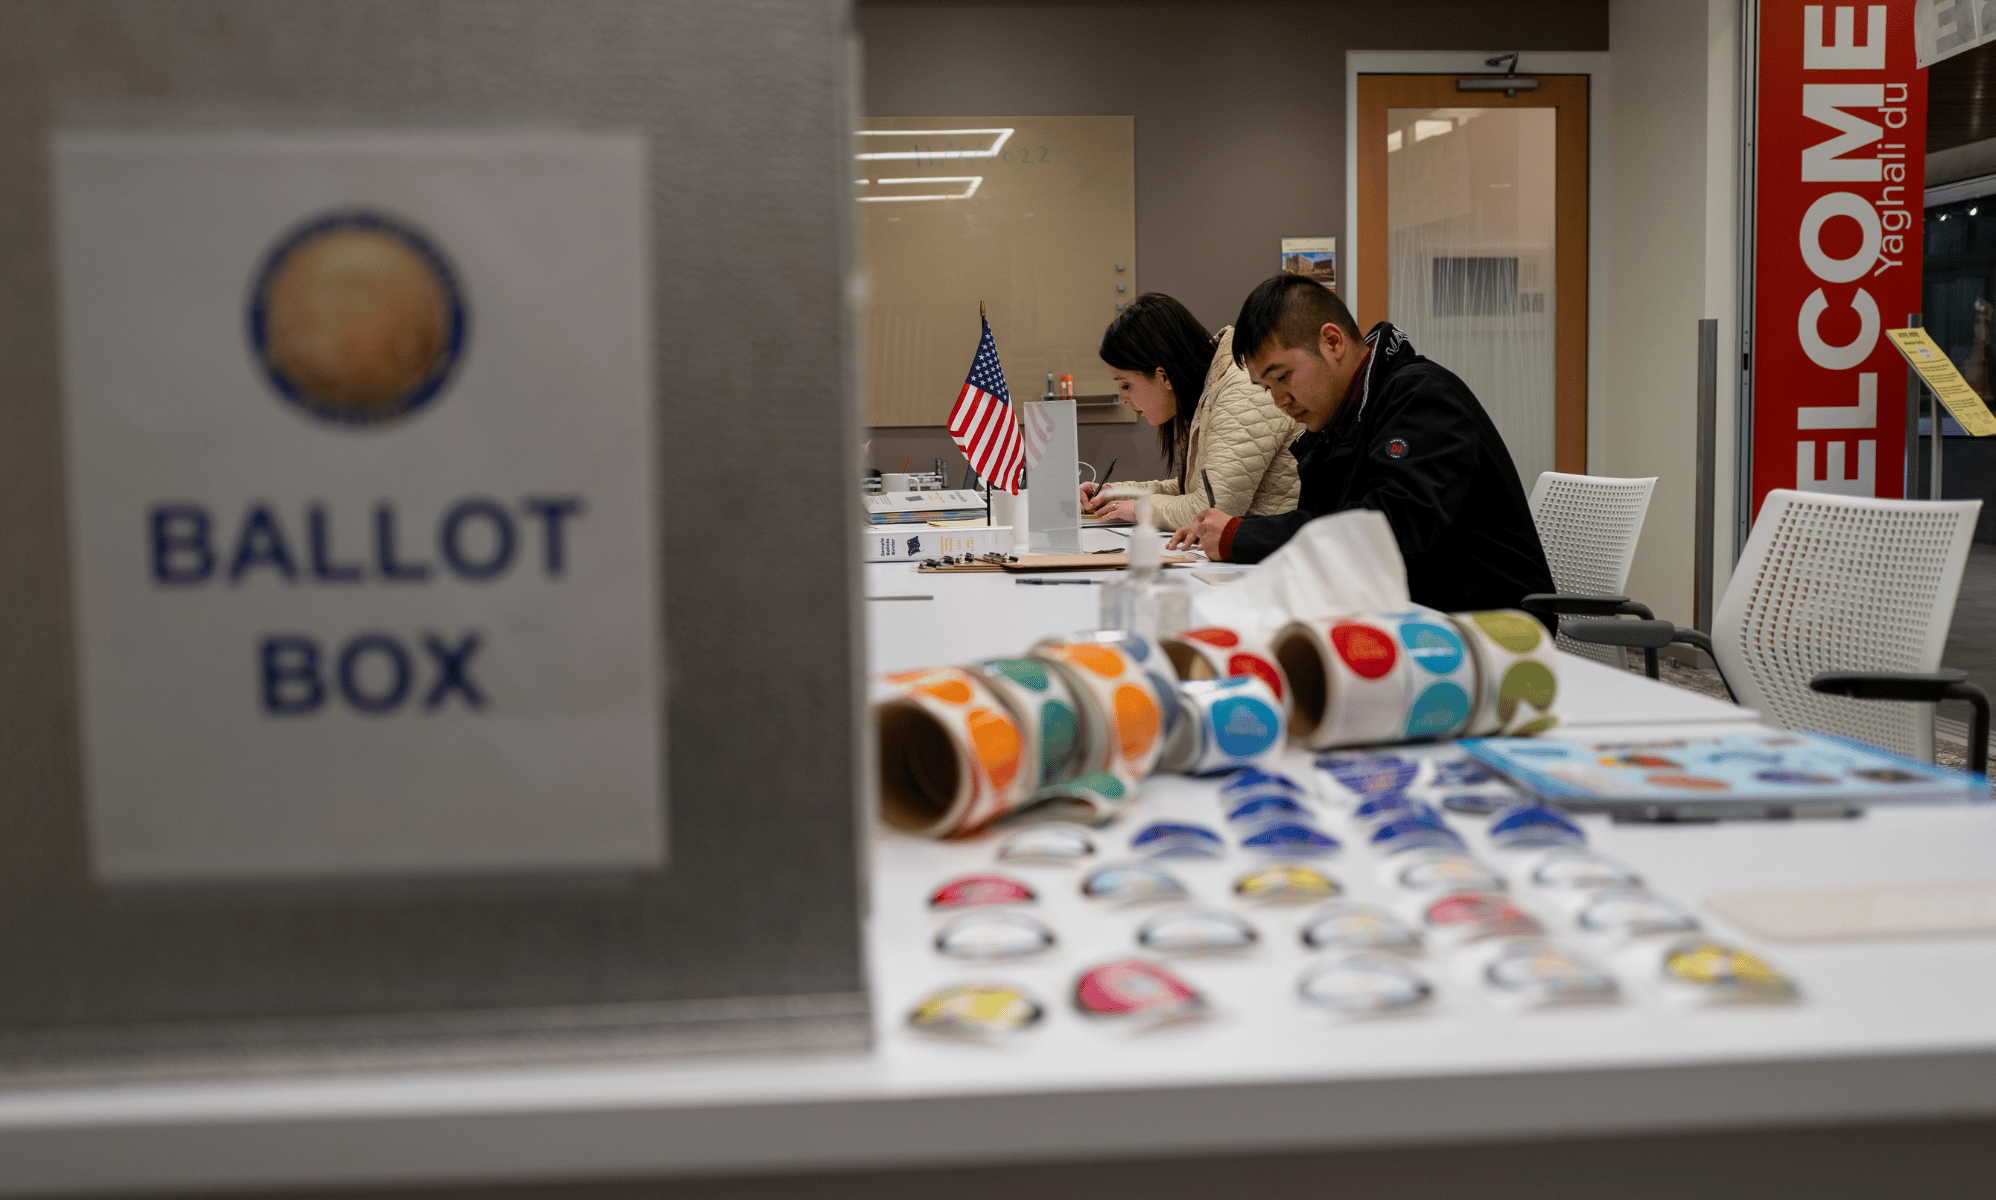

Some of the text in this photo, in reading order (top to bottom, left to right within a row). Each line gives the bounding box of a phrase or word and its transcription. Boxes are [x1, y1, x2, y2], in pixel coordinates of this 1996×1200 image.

[1796, 4, 1887, 497] ELCOME
[1873, 82, 1912, 277] Yaghali du
[147, 494, 586, 588] BALLOT
[258, 626, 489, 717] BOX
